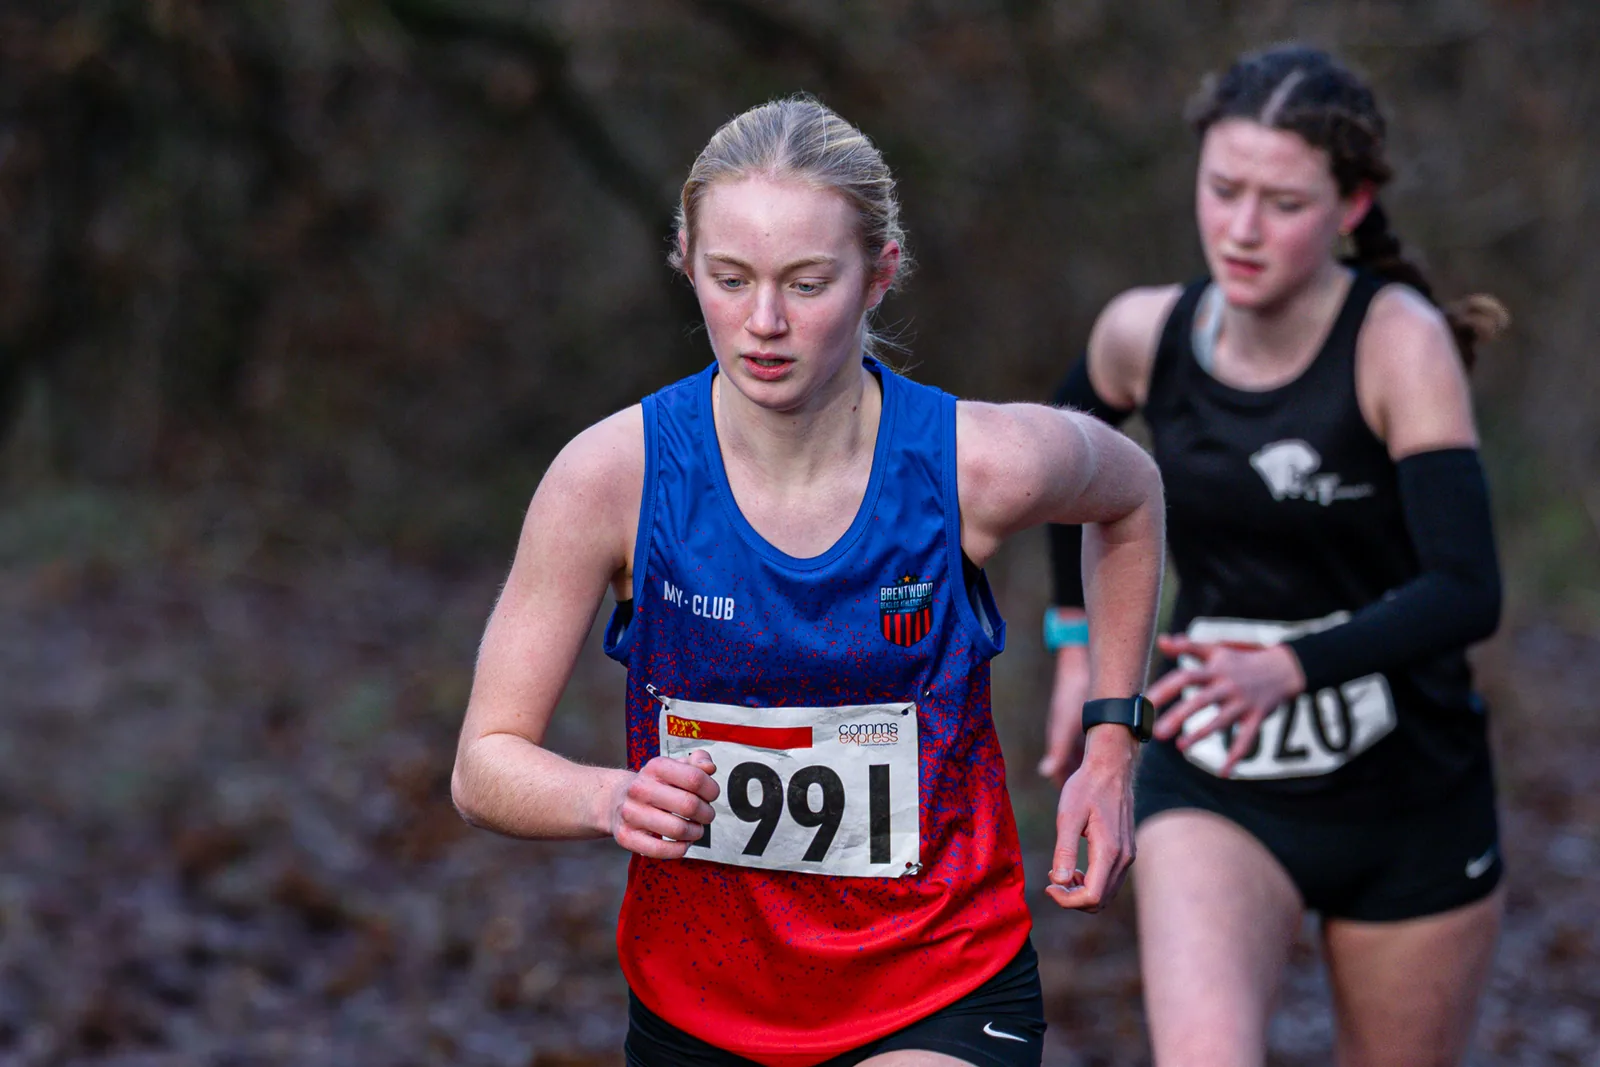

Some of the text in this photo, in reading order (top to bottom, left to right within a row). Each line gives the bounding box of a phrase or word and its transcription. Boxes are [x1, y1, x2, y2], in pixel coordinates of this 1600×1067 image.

[881, 582, 933, 601] BRENTWOOD
[692, 595, 735, 620] CLUB
[839, 722, 899, 735] comms
[1223, 687, 1352, 762] 20
[839, 732, 899, 746] express
[688, 752, 891, 864] 991
